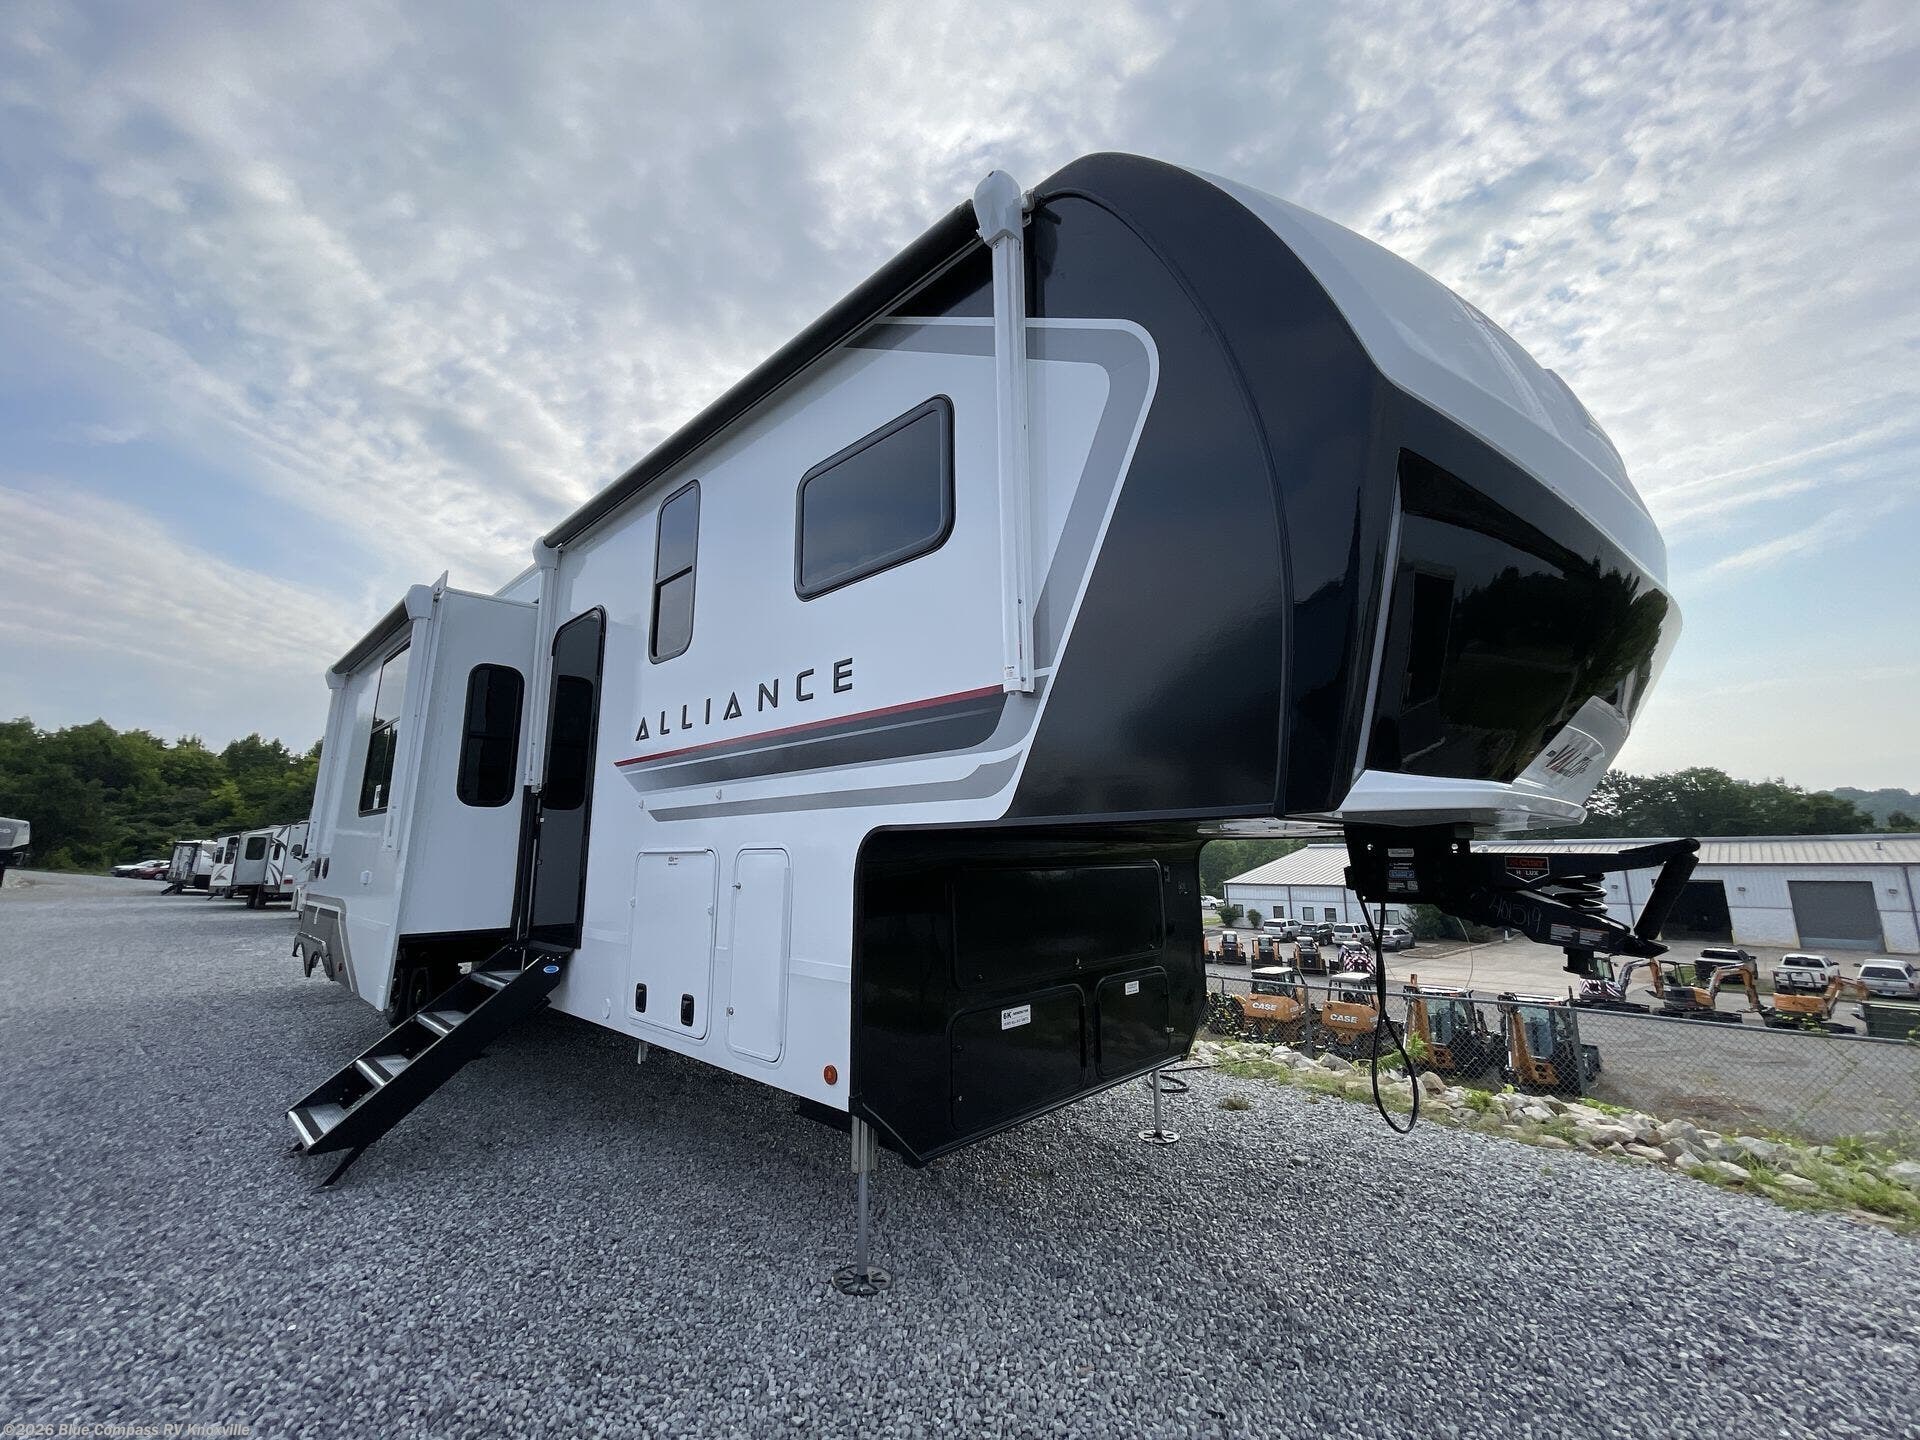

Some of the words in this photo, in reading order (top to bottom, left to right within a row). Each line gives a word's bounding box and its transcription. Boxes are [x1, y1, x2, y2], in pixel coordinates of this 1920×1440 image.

[635, 657, 853, 742] ALLIANCE
[1252, 1002, 1278, 1011] CASE
[1330, 1013, 1358, 1023] CASE
